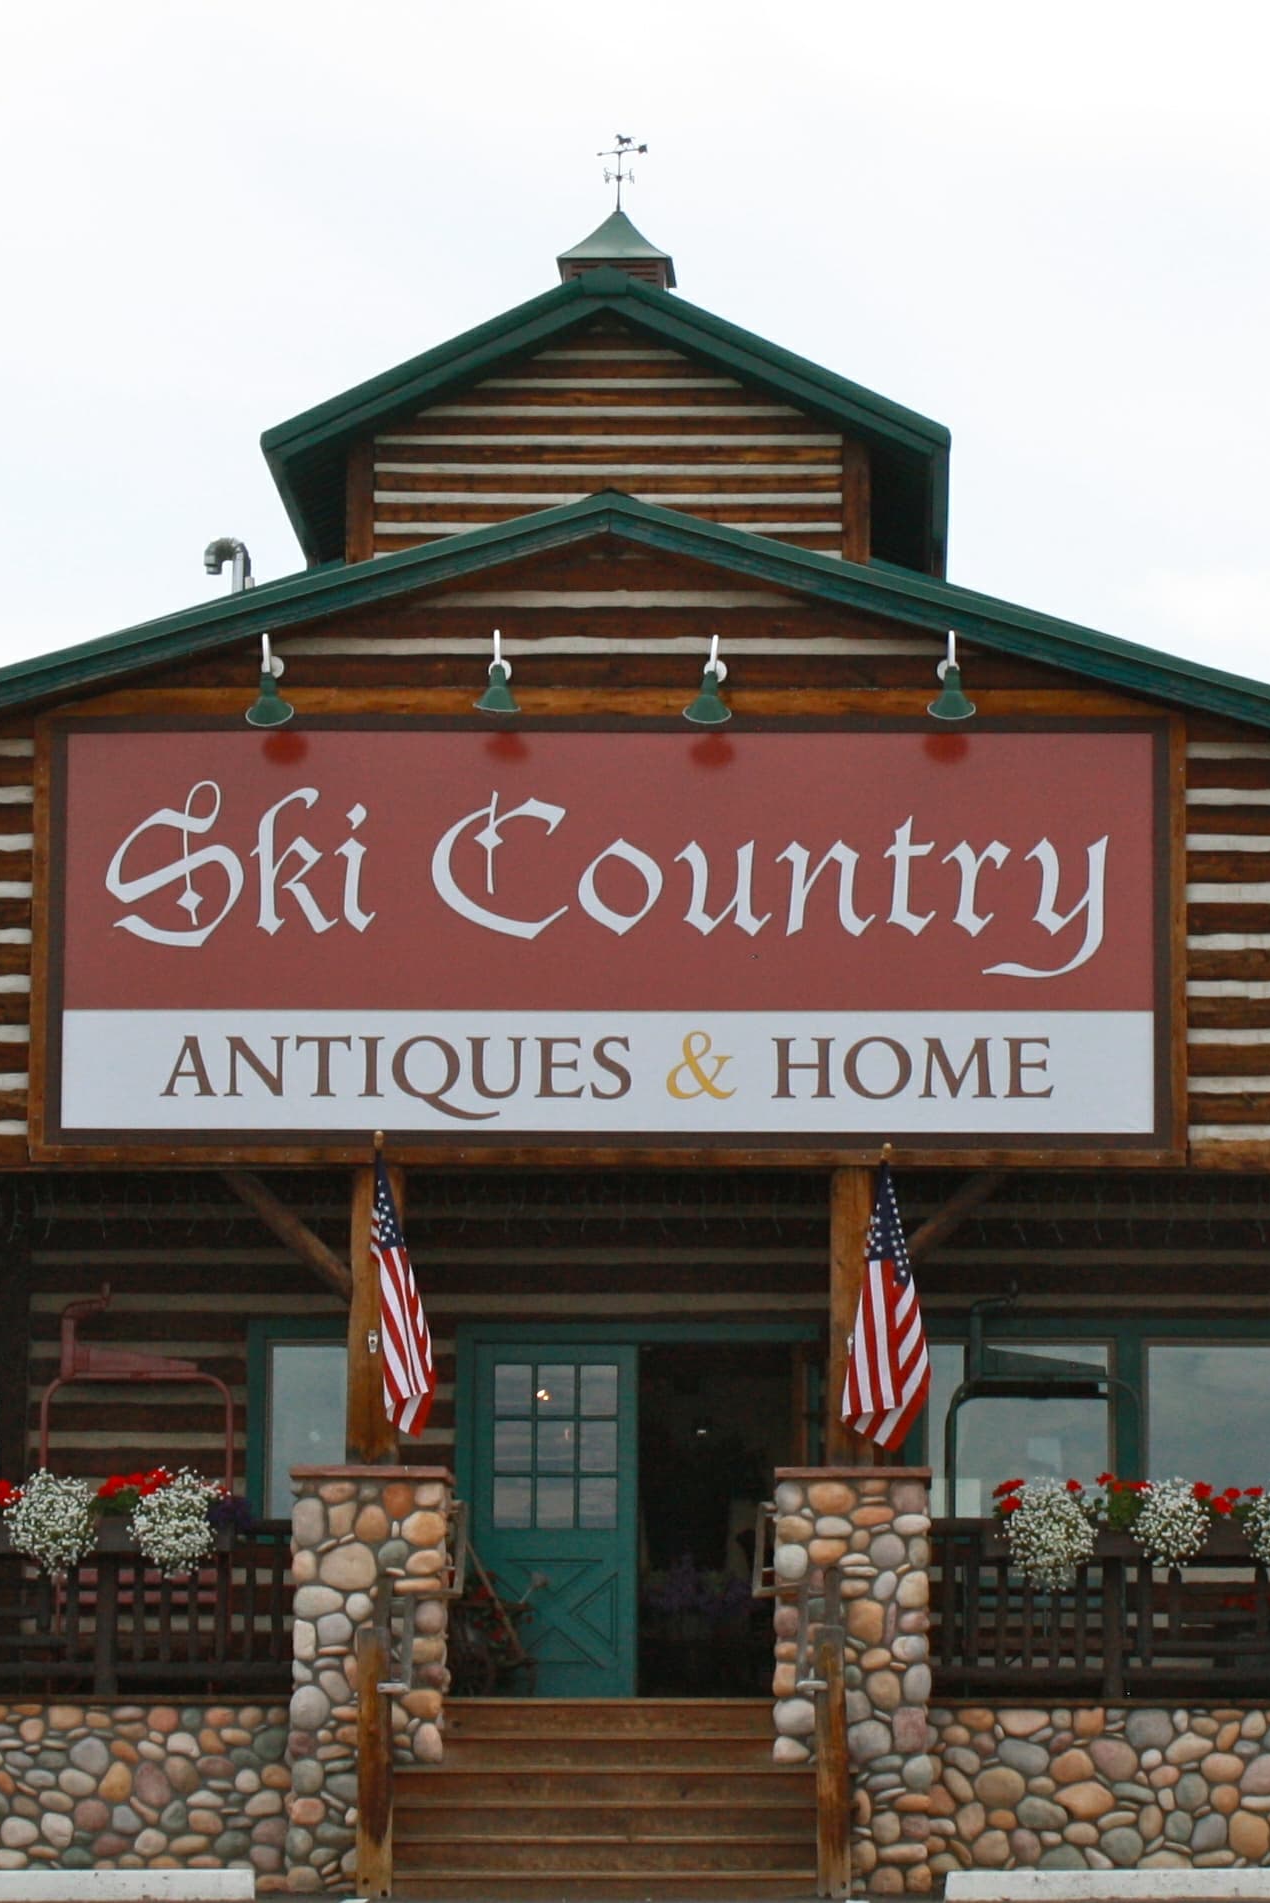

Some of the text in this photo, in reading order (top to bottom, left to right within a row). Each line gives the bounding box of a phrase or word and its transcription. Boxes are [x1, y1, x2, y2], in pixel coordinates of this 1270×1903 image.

[105, 780, 1110, 978] Ski Country
[159, 1030, 1055, 1120] ANTIQUES & HOME
